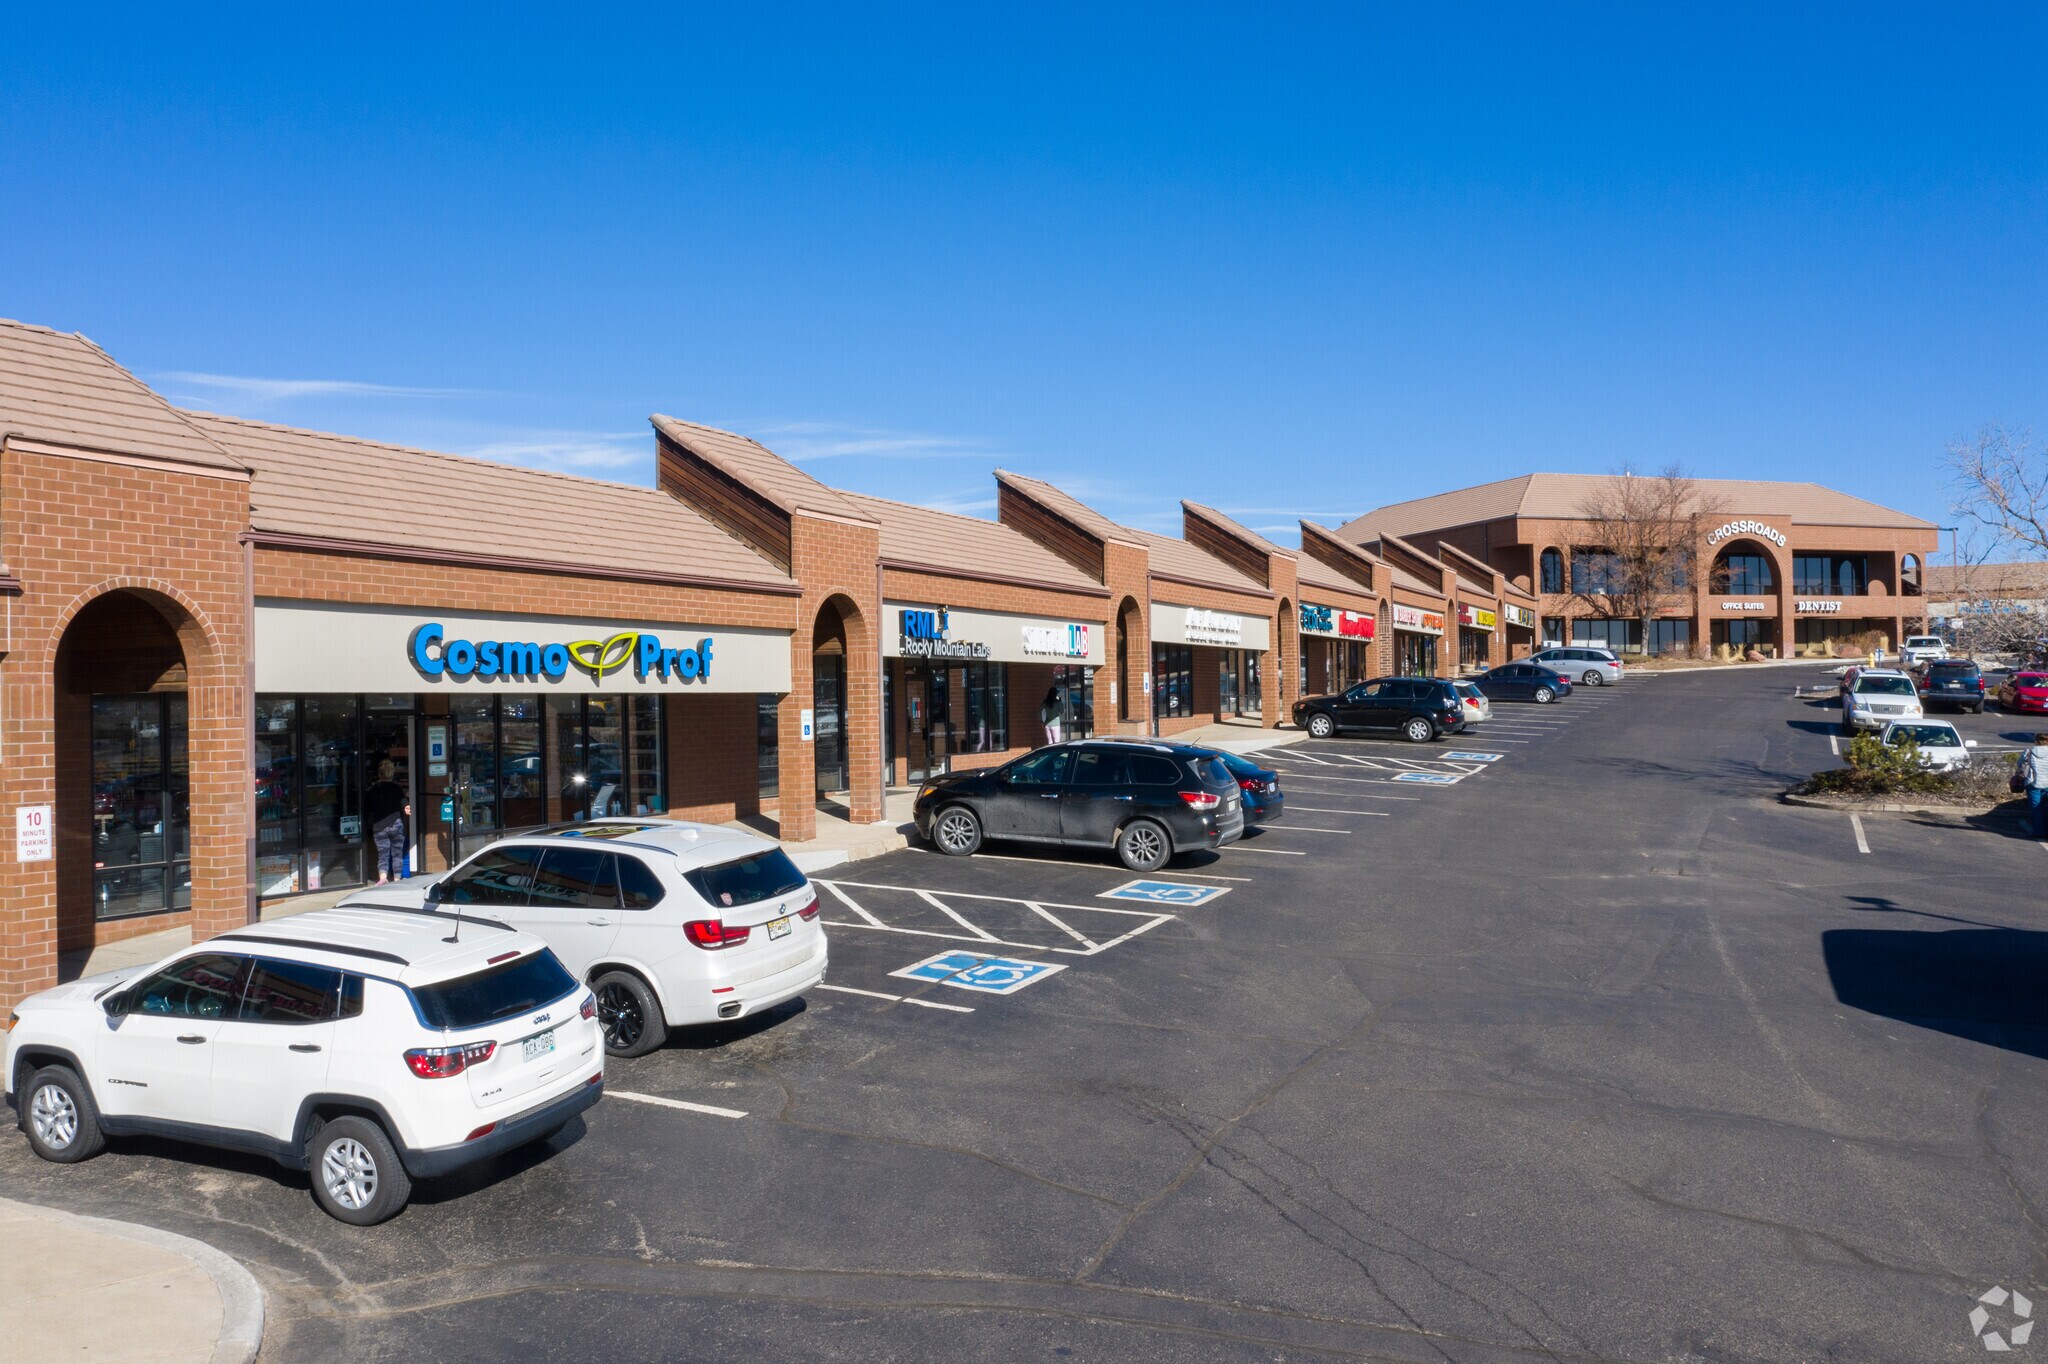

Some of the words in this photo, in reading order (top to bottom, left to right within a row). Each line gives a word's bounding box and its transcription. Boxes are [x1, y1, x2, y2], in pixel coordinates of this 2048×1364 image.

[1707, 520, 1787, 547] CROSSROADS
[1722, 602, 1743, 610] OFFICE
[1744, 602, 1765, 610] SUITES
[1798, 601, 1842, 611] DENTIST
[904, 610, 941, 639] RML
[414, 623, 569, 677] Cosmo
[640, 634, 713, 678] Prof
[905, 637, 933, 658] Rocky
[934, 639, 971, 657] Mountain
[972, 642, 992, 658] Labs
[1069, 626, 1088, 655] LAB
[26, 812, 41, 826] 10
[23, 829, 46, 837] MINUTE
